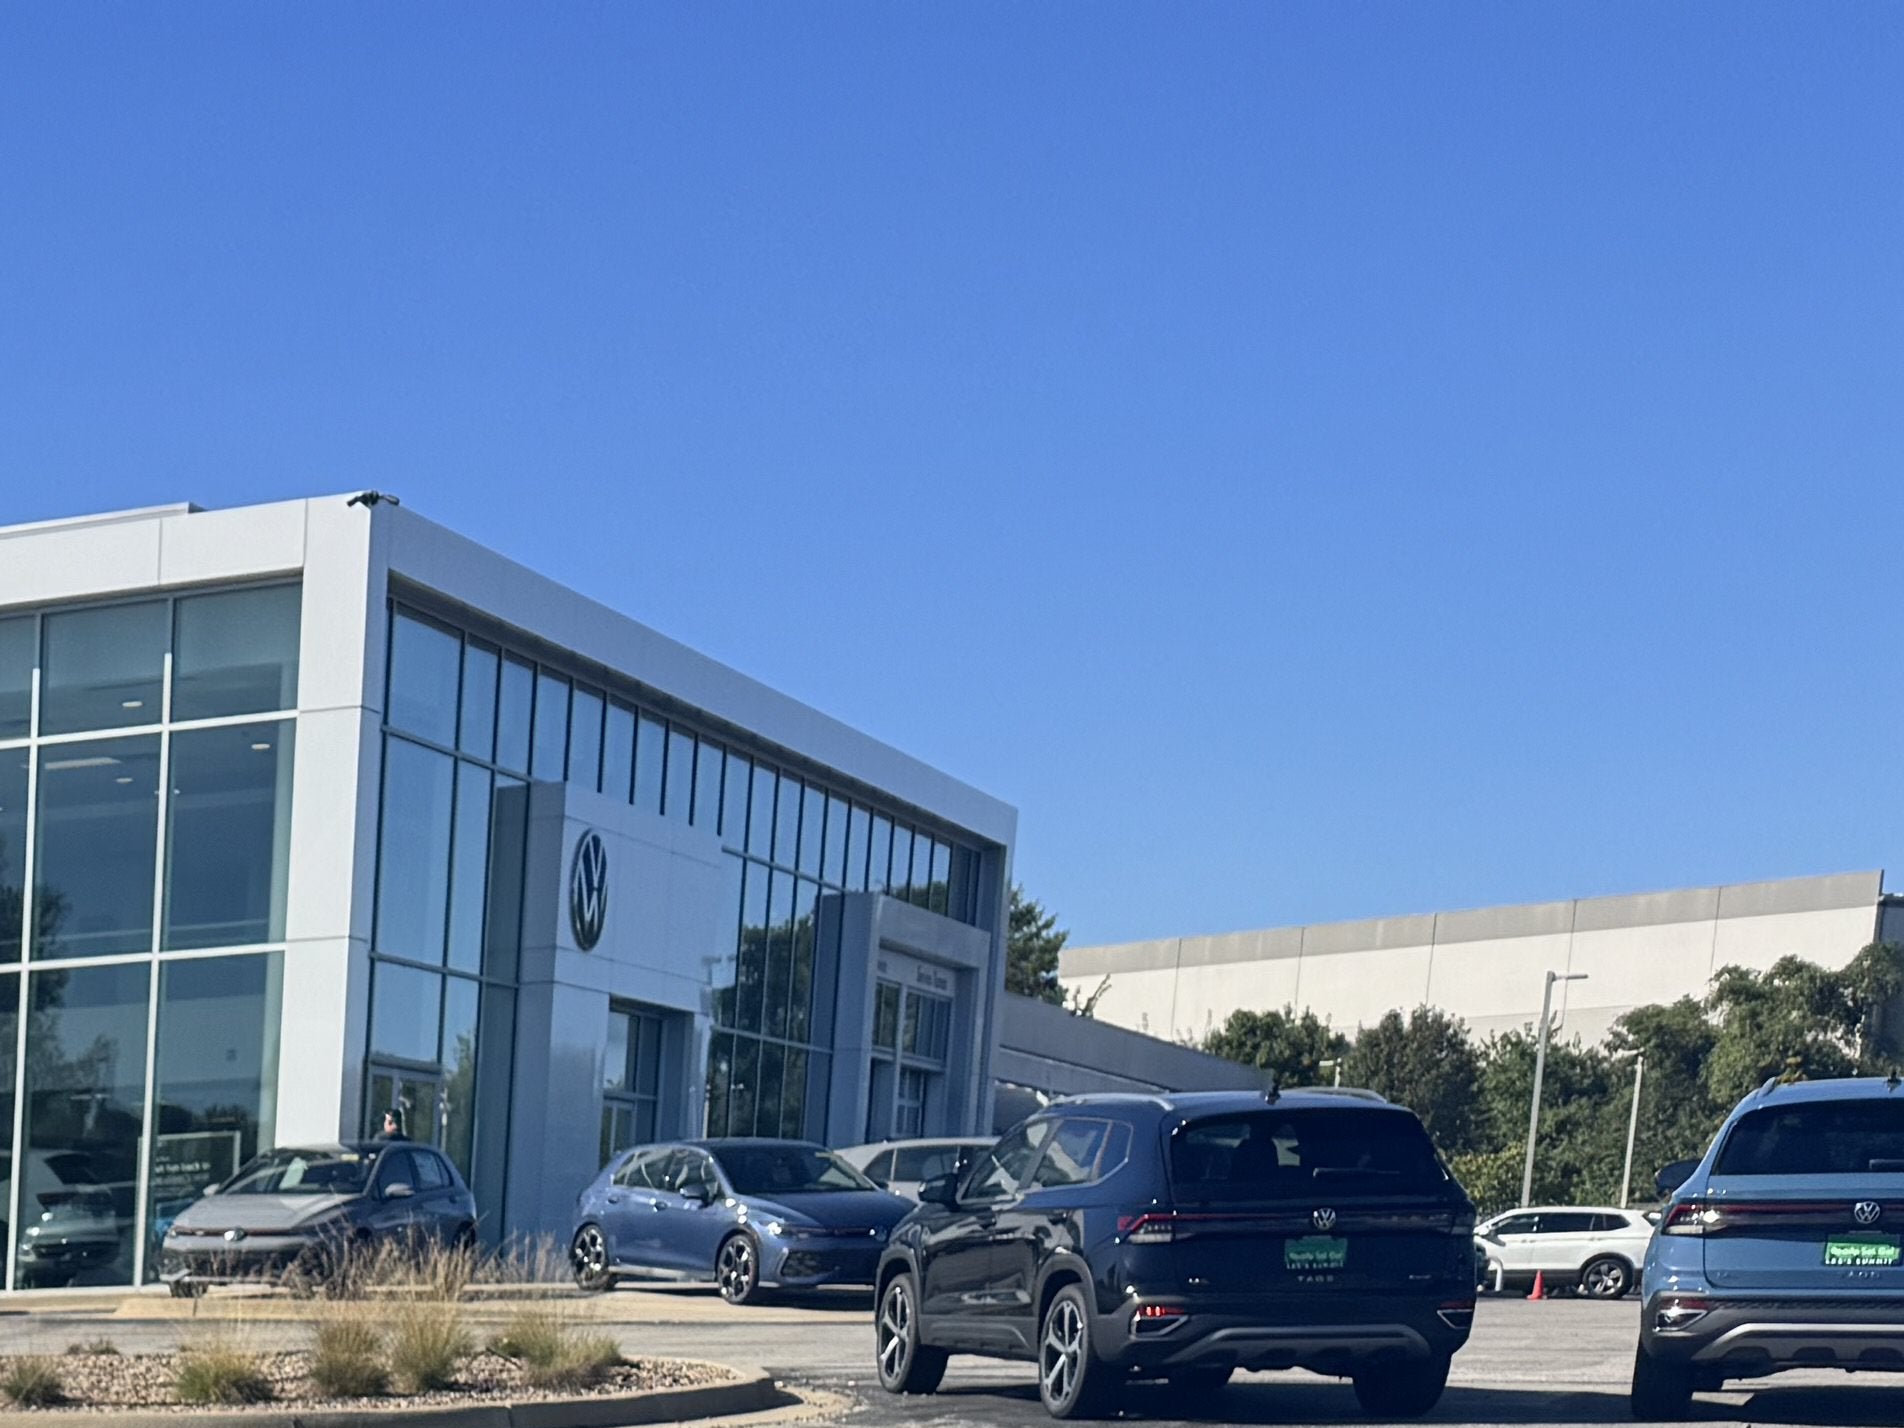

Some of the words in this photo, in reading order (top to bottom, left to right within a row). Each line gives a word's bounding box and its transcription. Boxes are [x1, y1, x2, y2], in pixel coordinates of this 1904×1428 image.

[570, 829, 608, 948] VW
[1313, 1207, 1337, 1230] VW
[1854, 1201, 1881, 1224] VW
